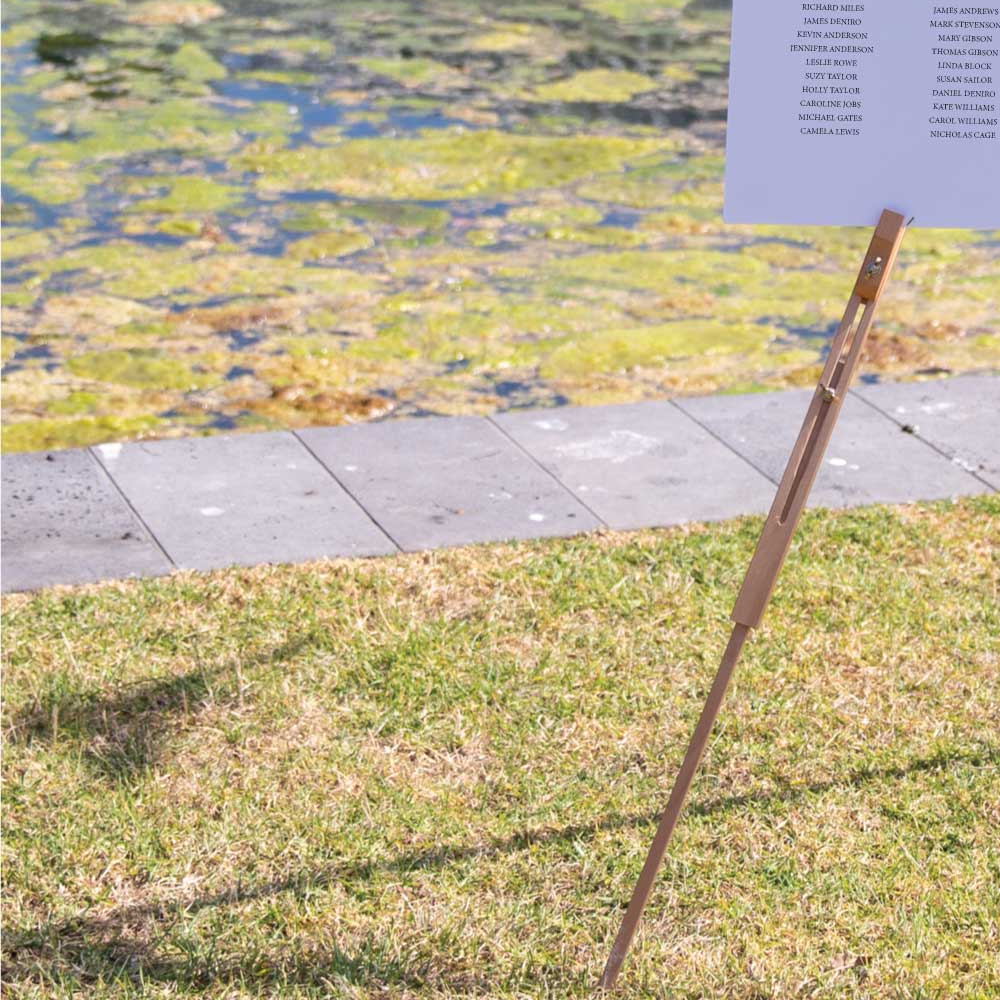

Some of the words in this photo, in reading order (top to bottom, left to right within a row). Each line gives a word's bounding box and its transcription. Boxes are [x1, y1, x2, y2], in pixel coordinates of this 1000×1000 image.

[801, 2, 839, 11] RICHARD
[839, 3, 865, 12] MILES
[932, 6, 958, 15] JAMES
[958, 6, 999, 15] ANDREWS
[929, 19, 953, 28] MARK
[796, 30, 822, 38] KEVIN
[822, 30, 868, 39] ANDERSON
[937, 33, 961, 42] MARY
[960, 34, 993, 43] GIBSON
[931, 47, 967, 56] THOMAS
[966, 48, 999, 57] GIBSON
[805, 57, 832, 66] LESLIE
[833, 58, 858, 67] ROWE
[937, 61, 963, 69] LINDA
[963, 61, 992, 70] BLOCK
[804, 71, 826, 80] SUZY
[826, 72, 858, 81] TAYLOR
[931, 88, 962, 97] DANIEL
[963, 89, 996, 98] DENIRO
[798, 99, 842, 108] CAROLINE
[842, 100, 862, 109] JOBS
[797, 113, 835, 121] MICHAEL
[836, 113, 863, 122] GATES
[799, 126, 834, 135] CAMELA
[835, 127, 860, 136] LEWIS
[929, 130, 973, 139] NICHOLAS
[972, 130, 996, 139] CAGE
